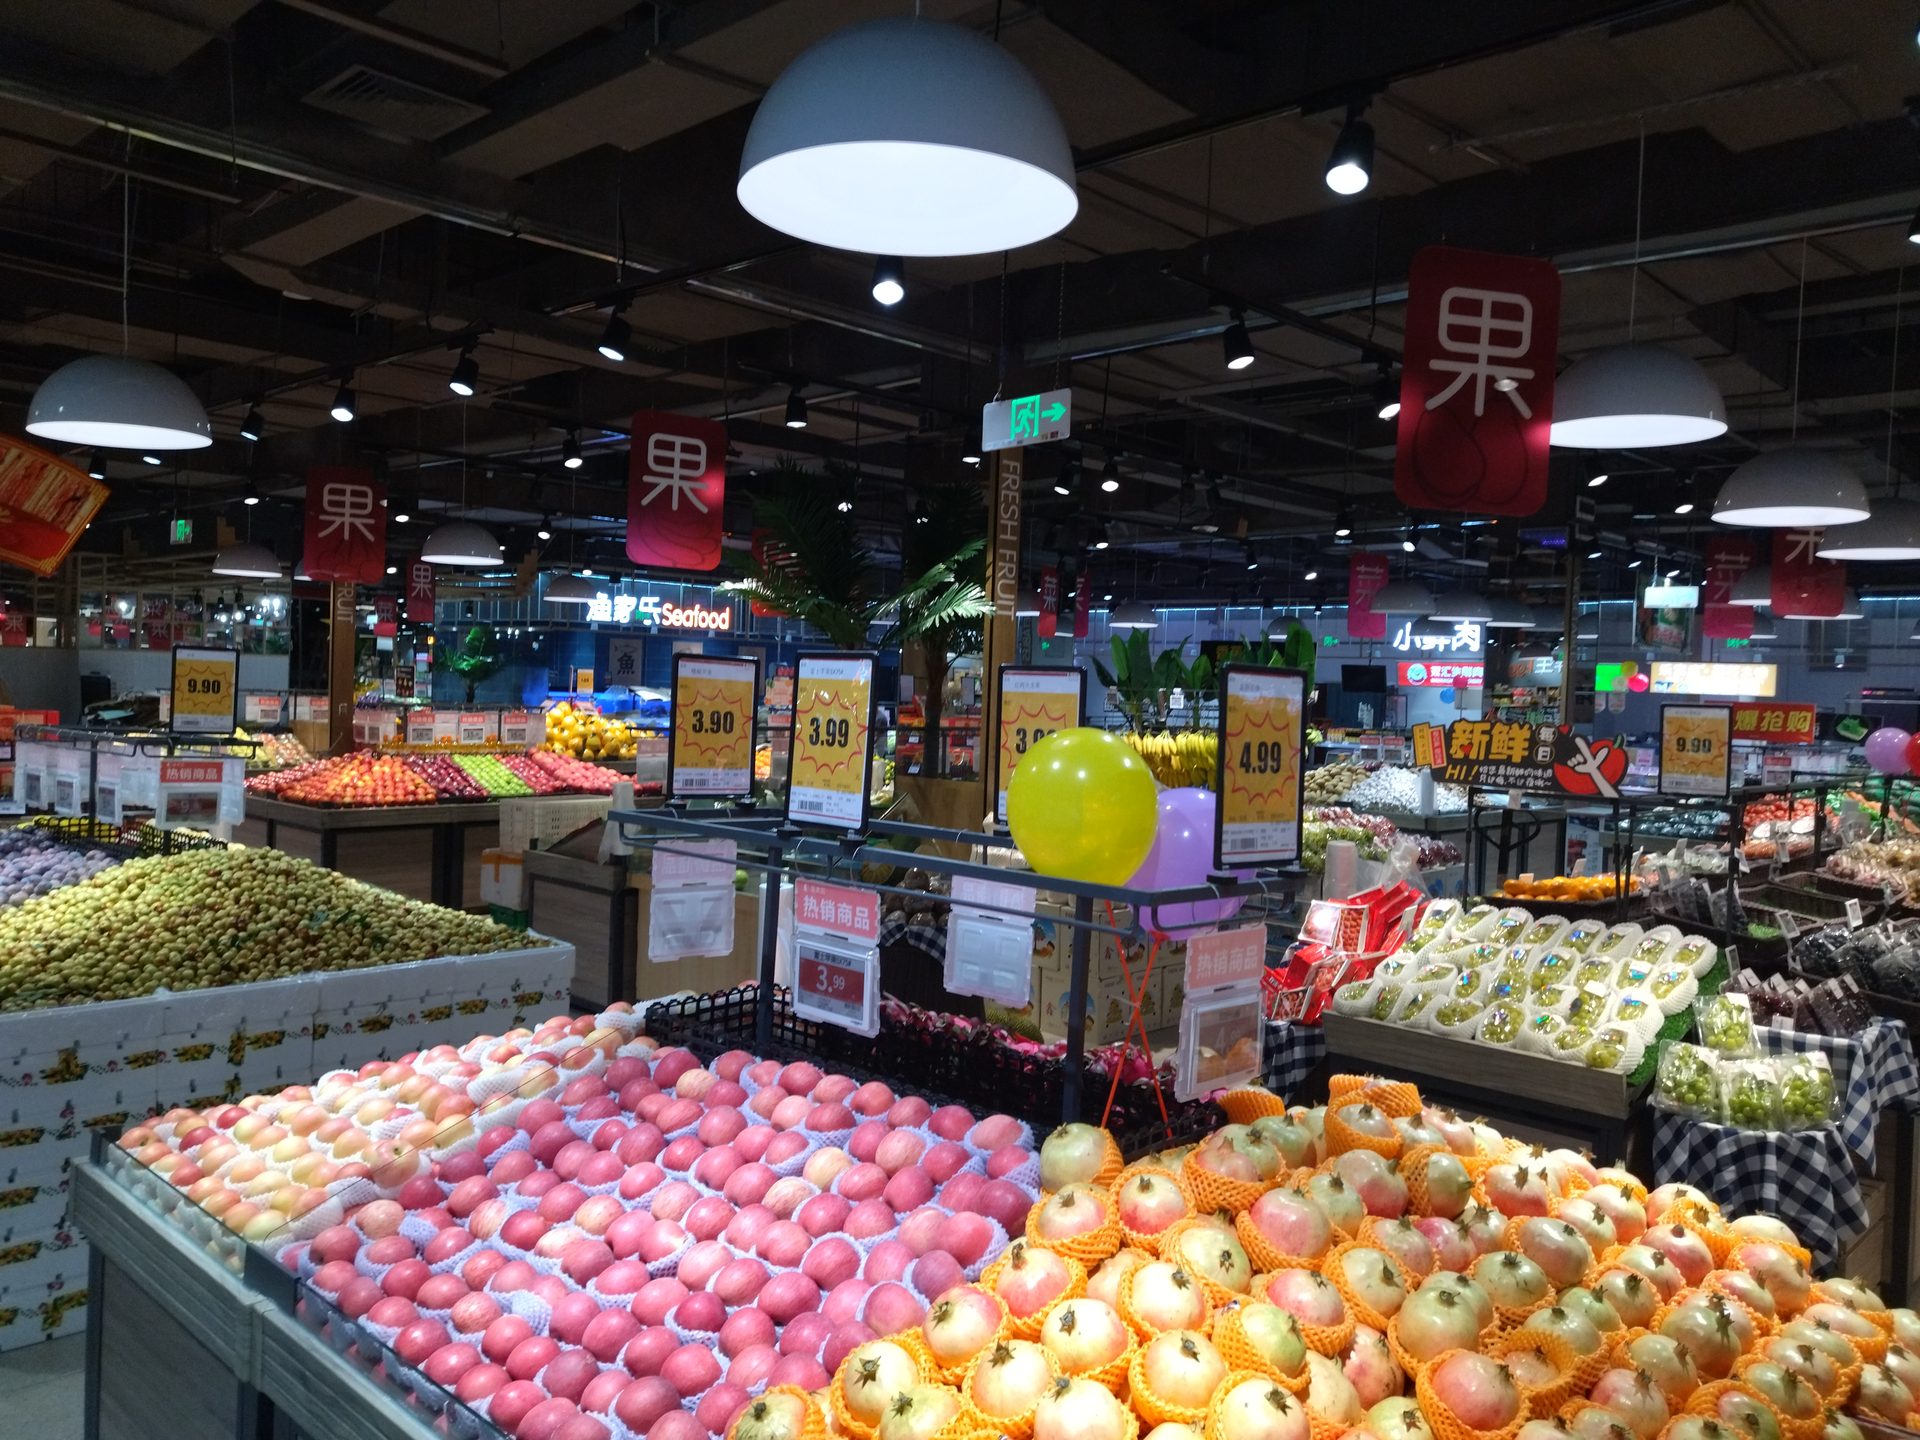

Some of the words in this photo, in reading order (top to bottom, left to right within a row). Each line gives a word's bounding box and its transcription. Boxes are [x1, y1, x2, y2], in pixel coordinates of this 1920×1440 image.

[1424, 286, 1536, 419] 果
[641, 432, 709, 514] 果
[317, 481, 376, 542] 果
[999, 459, 1022, 542] FRESH
[411, 564, 433, 599] 果
[995, 547, 1019, 622] FRUIT
[662, 602, 730, 630] Seafood
[616, 651, 636, 676] 魚
[187, 678, 222, 695] 9.90
[692, 709, 735, 735] 3.90
[808, 717, 850, 748] 3.99
[1239, 742, 1282, 775] 4.99
[1449, 721, 1532, 763] 新鲜
[1537, 726, 1556, 762] 每日
[166, 767, 219, 780] 热销商品
[802, 895, 871, 932] 热销商品
[815, 965, 846, 994] 3.99
[1196, 944, 1259, 981] 热销商品
